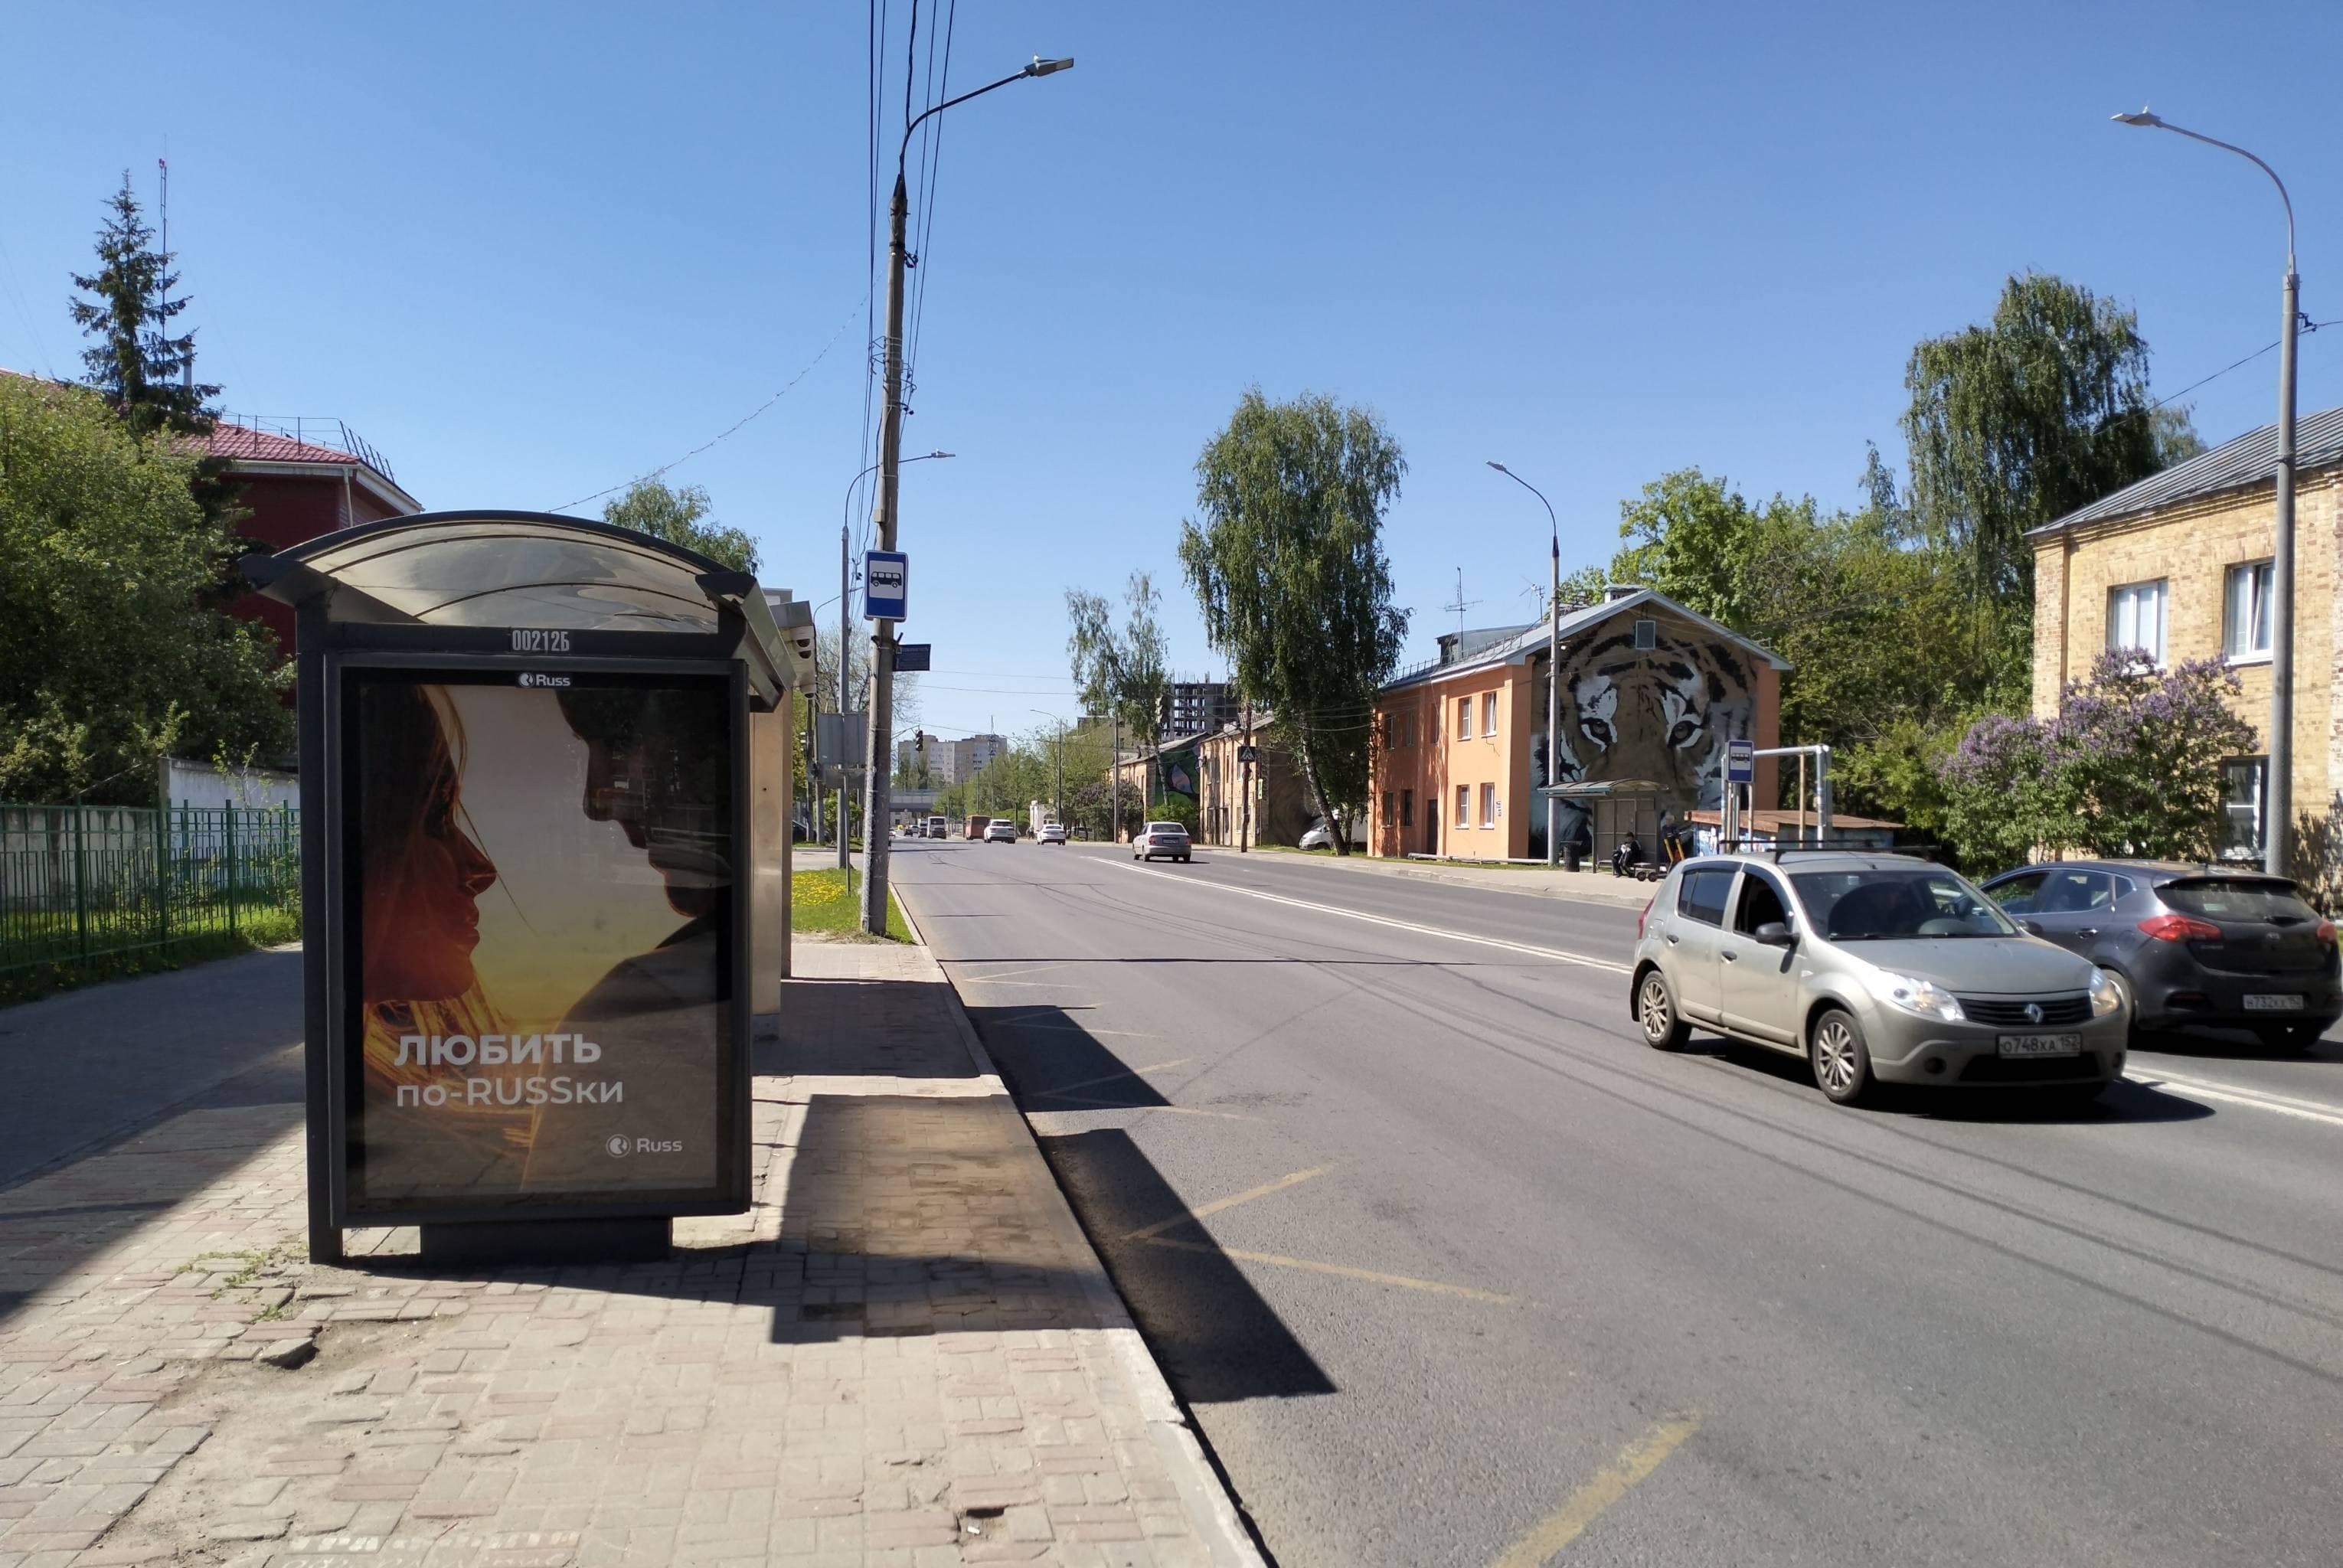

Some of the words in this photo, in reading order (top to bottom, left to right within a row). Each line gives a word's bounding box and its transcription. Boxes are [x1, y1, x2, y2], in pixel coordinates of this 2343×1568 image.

[536, 675, 571, 686] Russ
[394, 1034, 602, 1066] ЛЮБИТЬ
[397, 1076, 624, 1107] по-RUSSки
[637, 1138, 683, 1153] Russ
